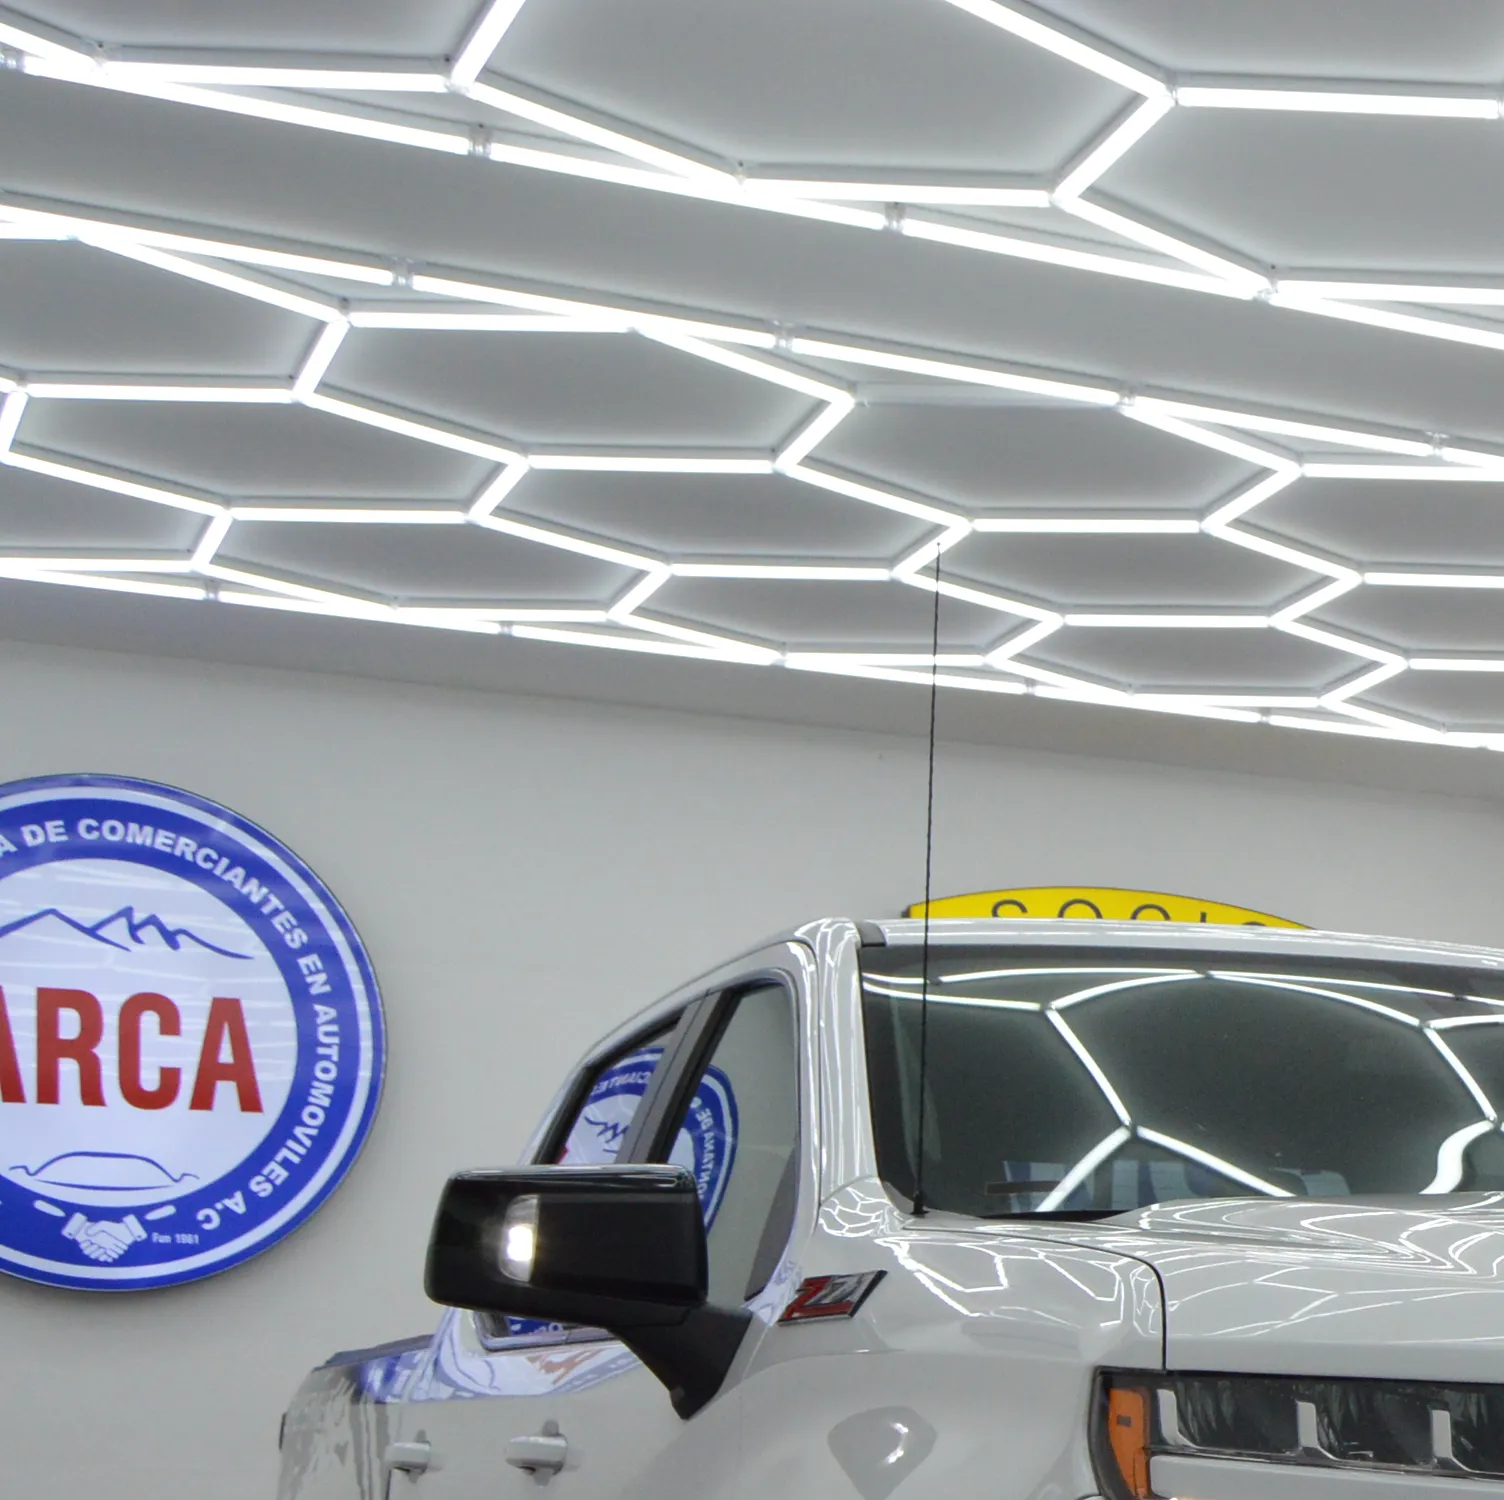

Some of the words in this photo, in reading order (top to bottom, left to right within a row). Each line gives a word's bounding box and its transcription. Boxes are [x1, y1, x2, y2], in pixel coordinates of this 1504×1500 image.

[20, 820, 68, 847] DE
[77, 818, 308, 949] COMERCIANTES
[297, 953, 332, 995] EN
[249, 1004, 341, 1197] AUTOMOVILES
